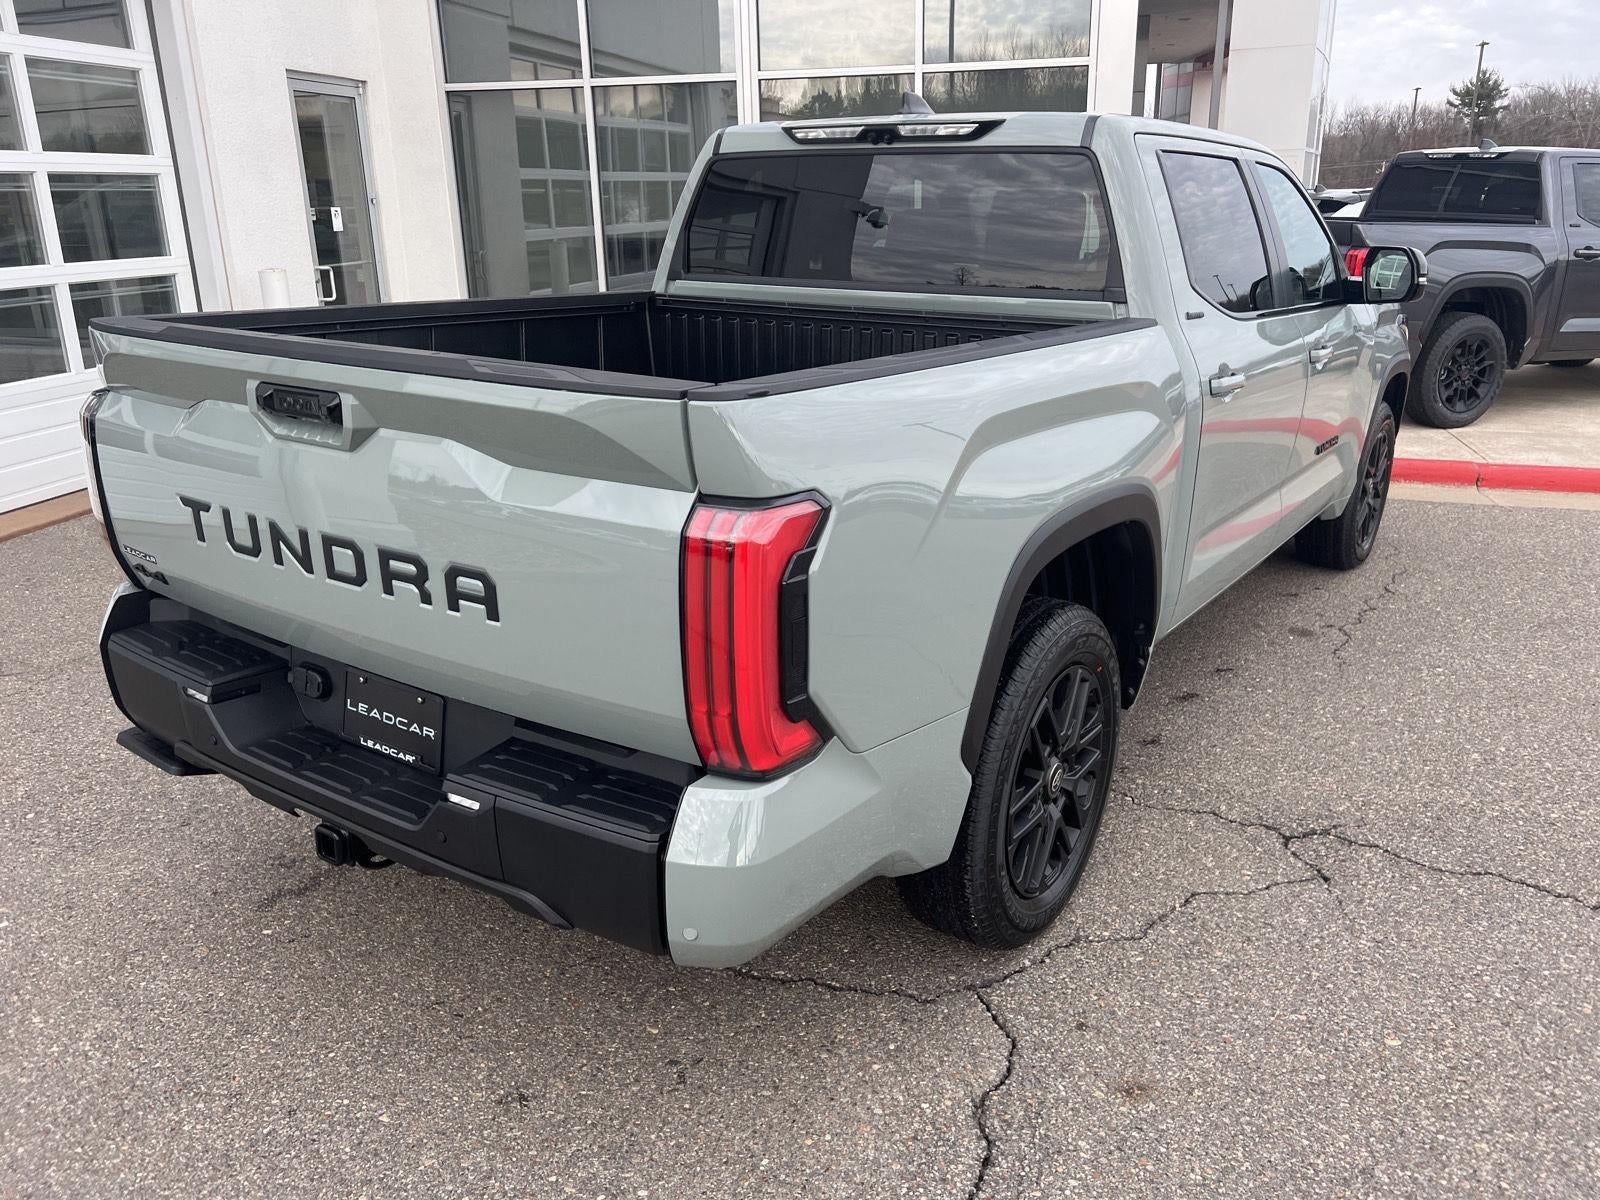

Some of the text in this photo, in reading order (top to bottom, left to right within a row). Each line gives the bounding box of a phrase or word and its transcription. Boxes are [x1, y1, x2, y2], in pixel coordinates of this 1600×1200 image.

[177, 494, 500, 625] TUNDRA
[347, 698, 436, 740] LEADCAR
[360, 737, 415, 763] LEADCAR
